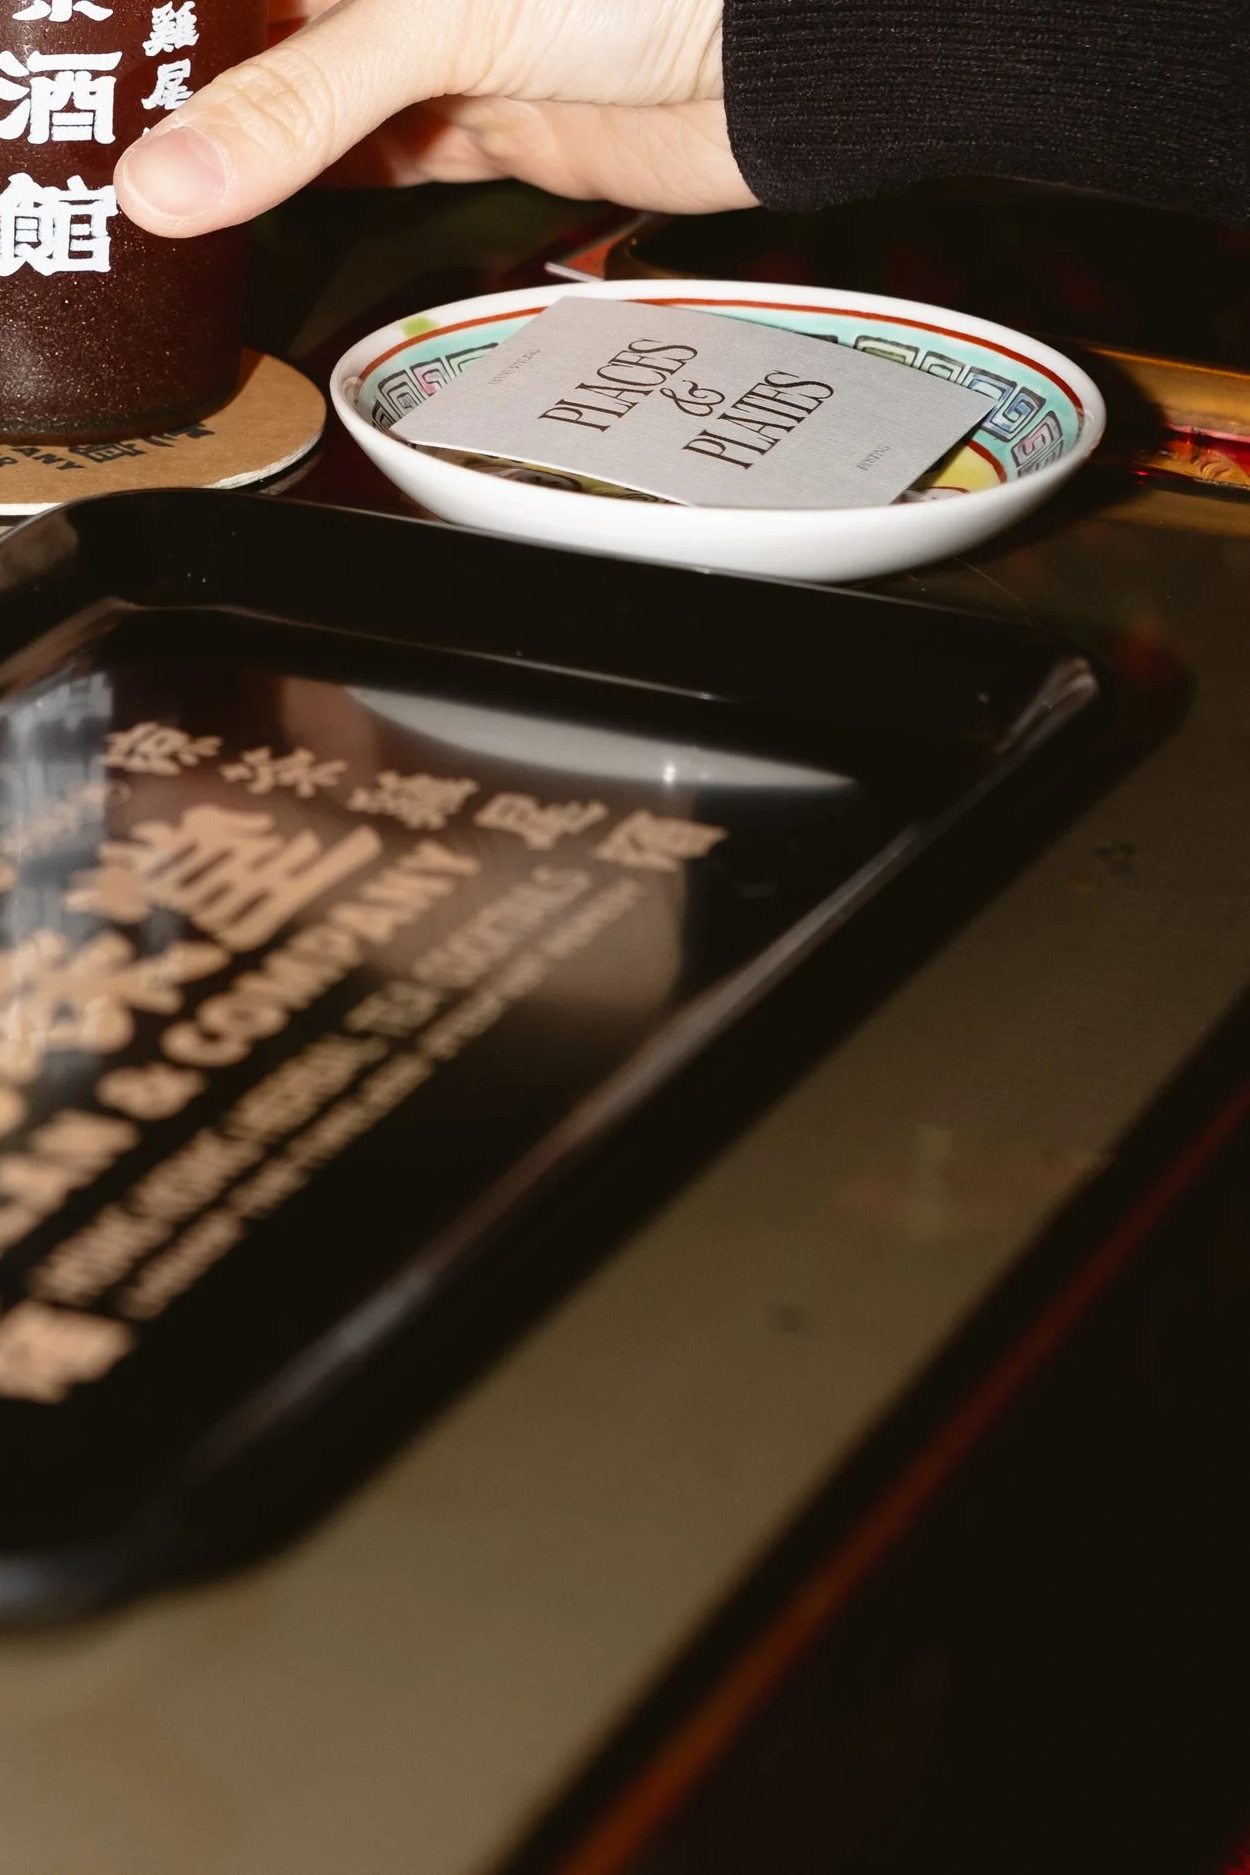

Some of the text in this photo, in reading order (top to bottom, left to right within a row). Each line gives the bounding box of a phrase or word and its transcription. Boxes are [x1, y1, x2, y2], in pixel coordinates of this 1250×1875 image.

[537, 338, 698, 432] PLACES
[659, 379, 726, 417] &
[681, 370, 835, 470] PLATES
[96, 1065, 206, 1120] &
[160, 839, 480, 1067] COMPANY
